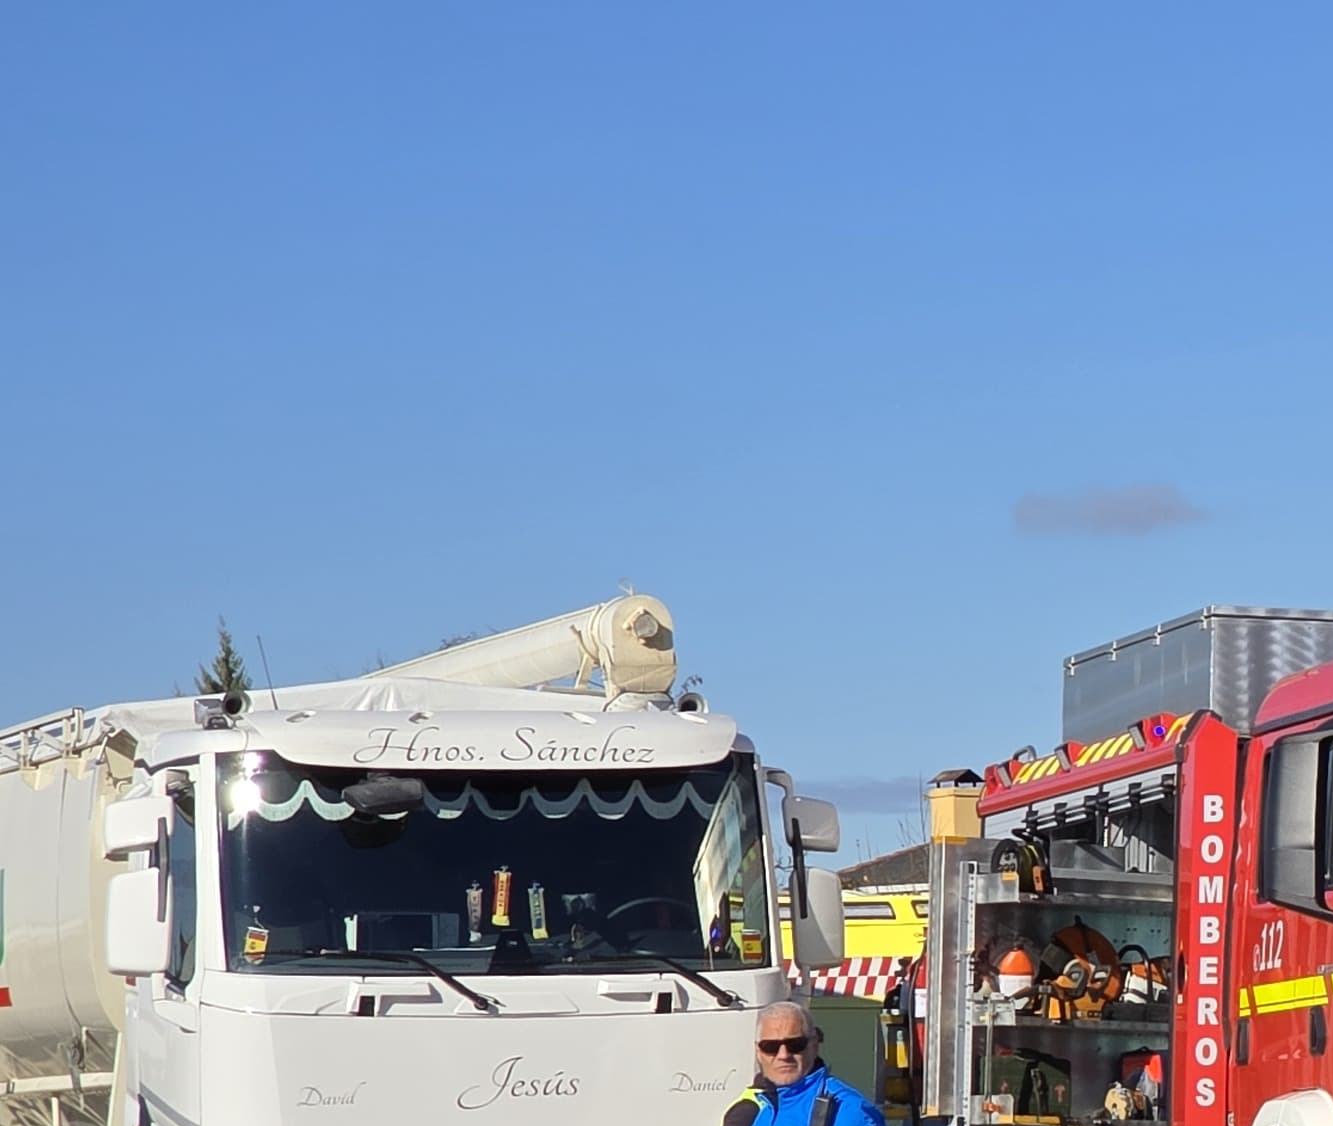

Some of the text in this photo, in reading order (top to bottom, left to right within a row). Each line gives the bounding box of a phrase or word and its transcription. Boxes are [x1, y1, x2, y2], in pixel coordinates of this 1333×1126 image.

[353, 725, 656, 764] Hnos. Sánchez
[1195, 795, 1224, 1107] BOMBEROS
[1259, 919, 1284, 972] 112
[296, 1081, 367, 1108] David
[456, 1055, 581, 1111] Jesús
[668, 1068, 737, 1093] Daniel
